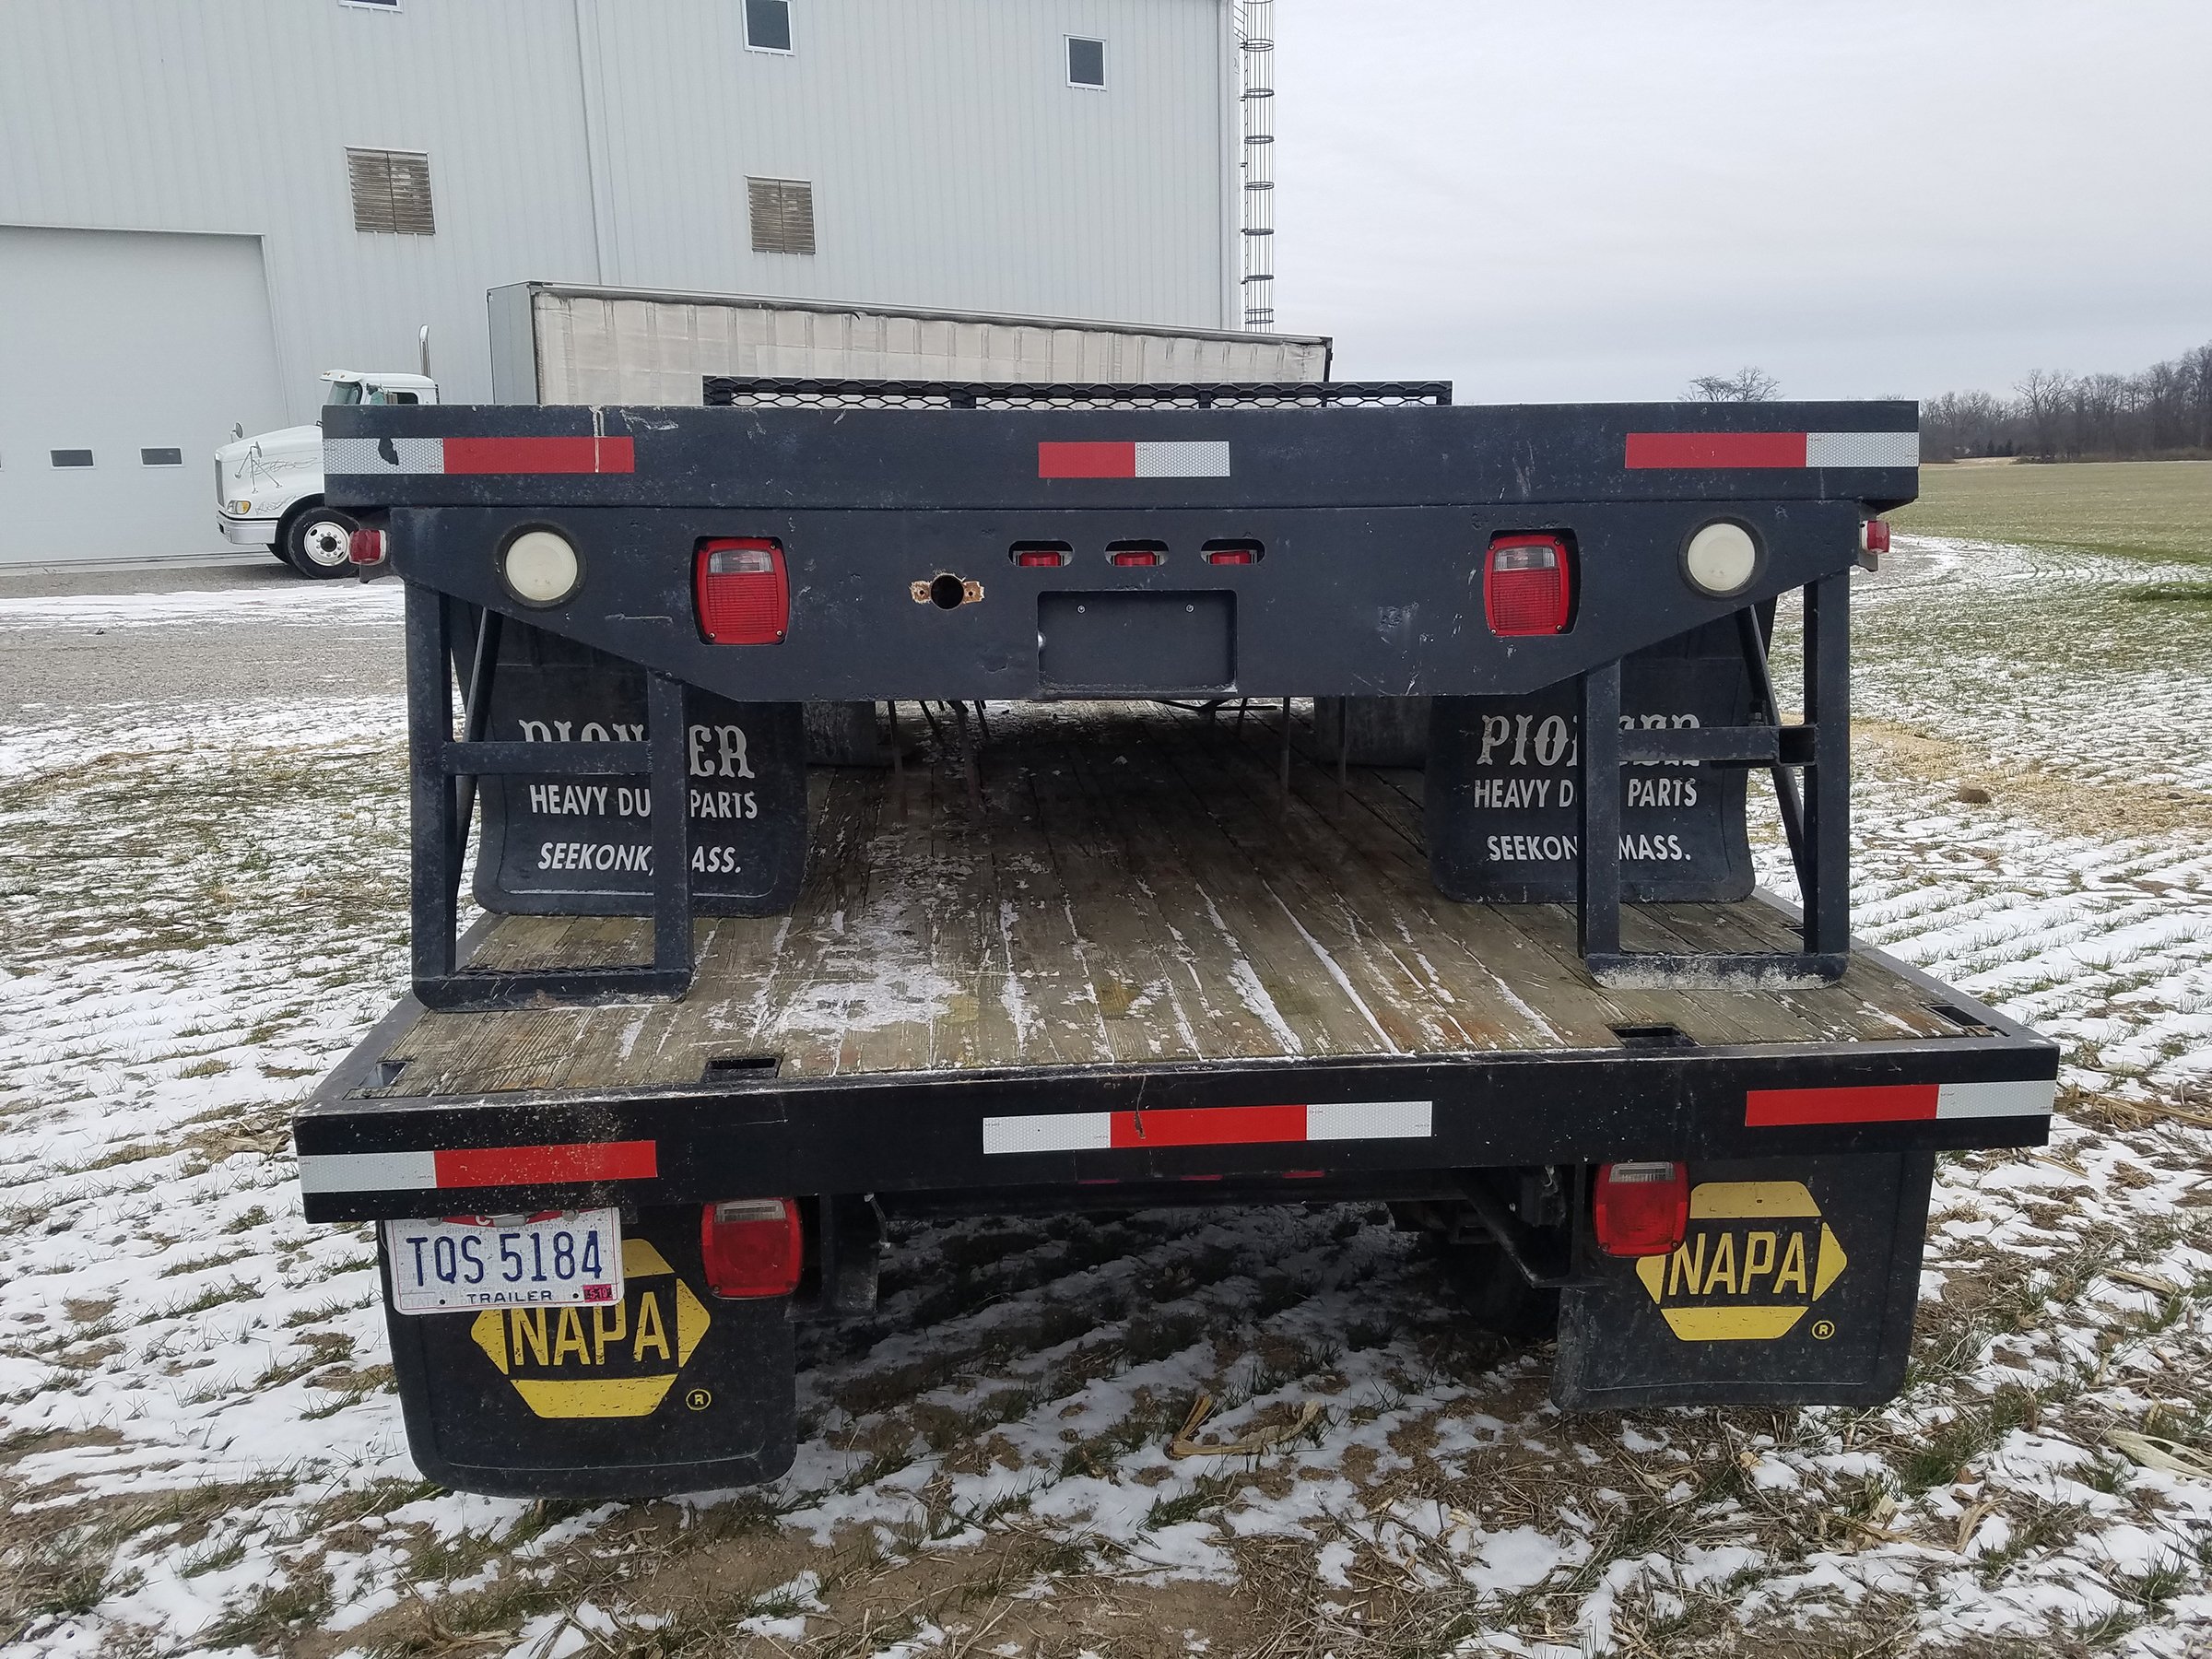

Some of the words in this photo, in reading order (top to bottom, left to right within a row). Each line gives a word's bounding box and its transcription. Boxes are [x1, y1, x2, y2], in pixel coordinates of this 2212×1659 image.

[529, 784, 608, 816] HEAVY
[690, 789, 758, 818] PARTS
[1474, 779, 1551, 808] HEAVY
[1627, 777, 1698, 806] PARTS
[691, 846, 742, 873] ASS.
[1486, 834, 1579, 862] SEEKON
[1618, 833, 1692, 861] MASS.
[406, 1234, 484, 1287] TQS
[499, 1230, 603, 1282] 5184
[1667, 1231, 1806, 1296] NAPA
[466, 1289, 553, 1305] TRAILER
[510, 1291, 671, 1367] NAPA
